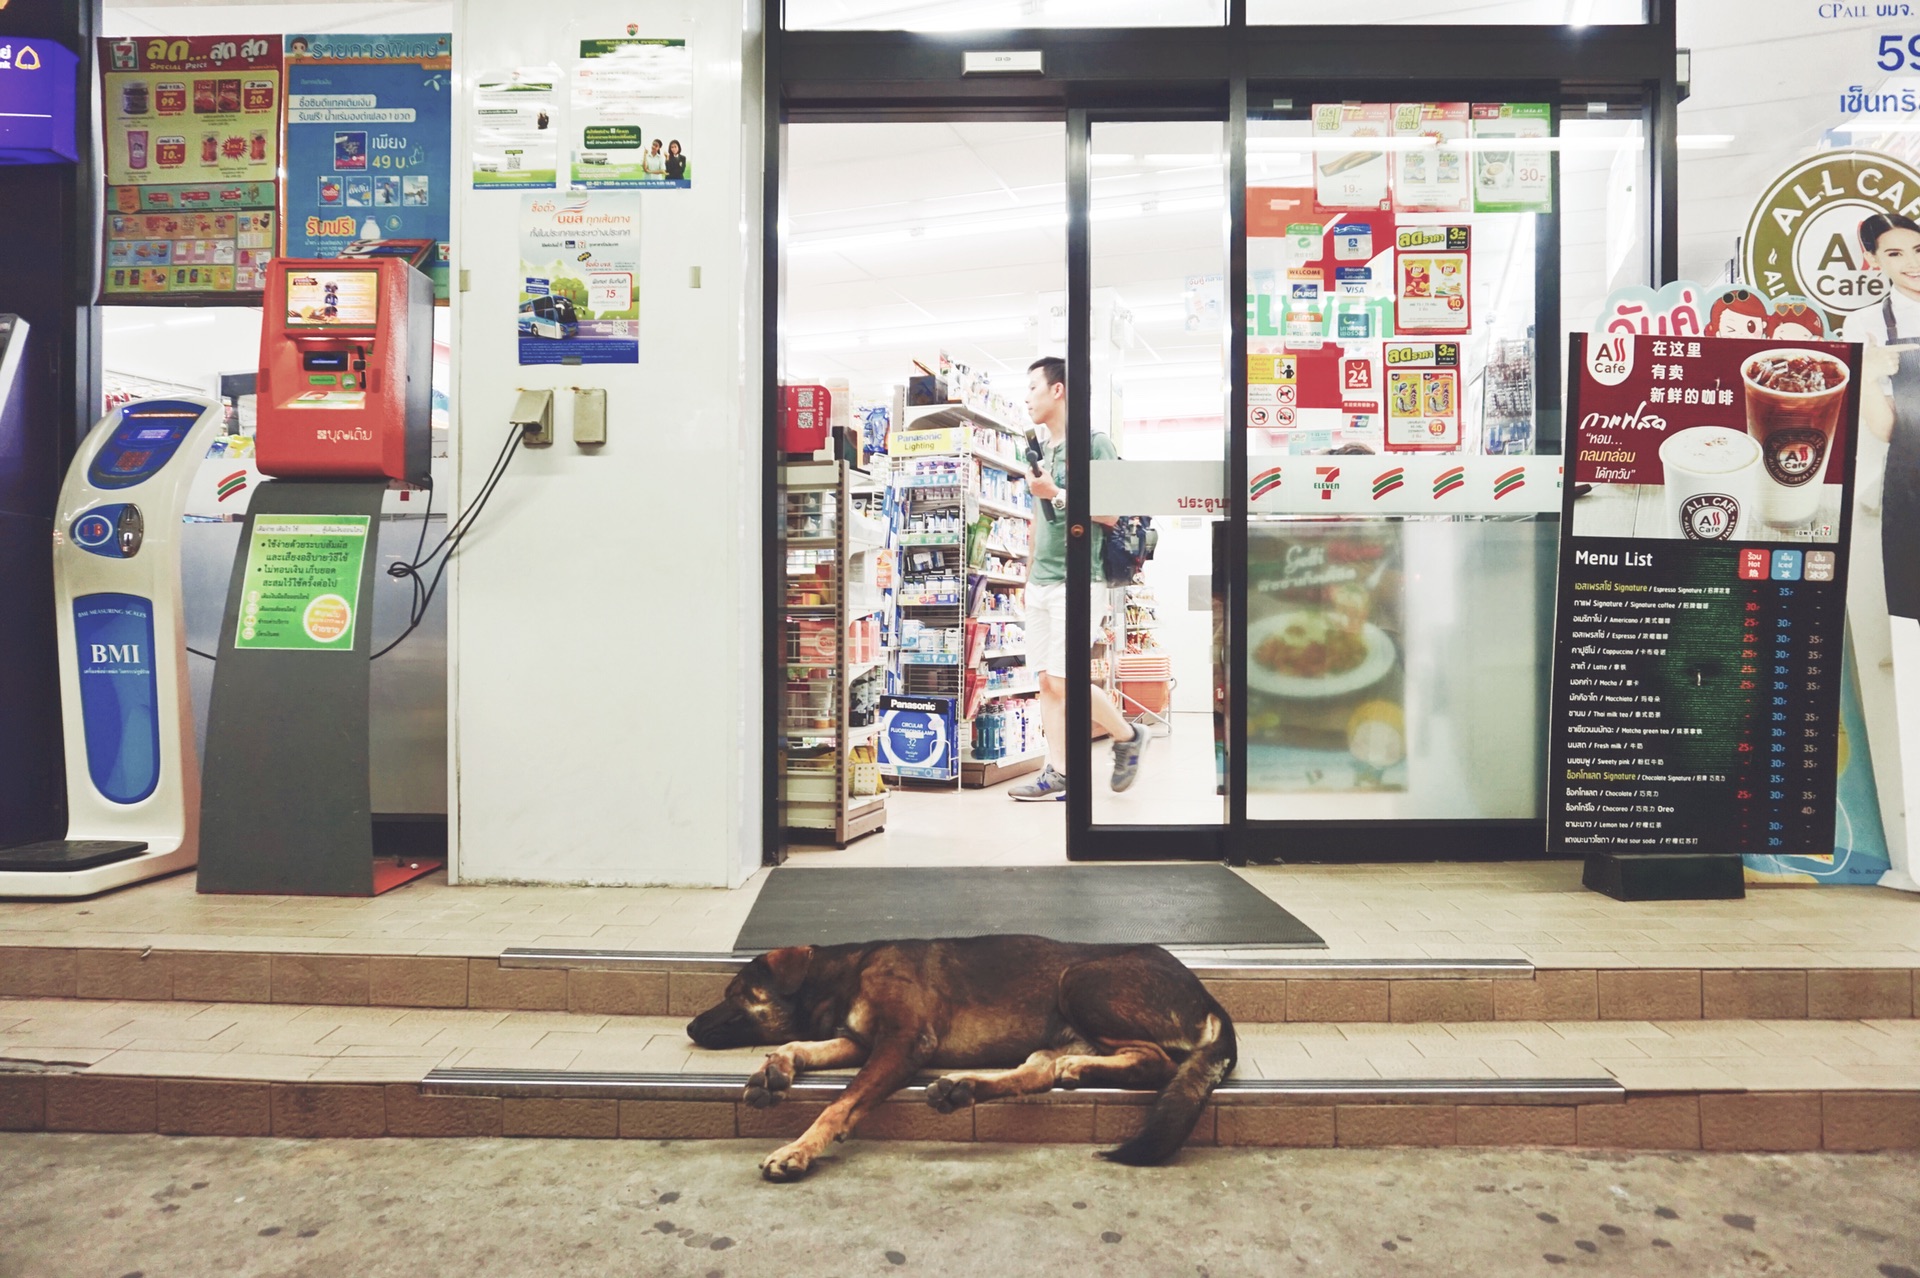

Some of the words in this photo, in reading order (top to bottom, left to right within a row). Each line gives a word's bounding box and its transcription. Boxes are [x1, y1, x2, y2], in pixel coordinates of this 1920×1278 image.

[1876, 4, 1915, 17] บมจ.
[150, 62, 181, 70] SPECIAL
[185, 62, 208, 70] PRICE
[372, 134, 407, 150] เพียง
[372, 155, 392, 169] 49
[1772, 170, 1845, 236] ALL
[306, 215, 355, 236] รับฟรี!
[586, 214, 631, 226] ทุกเส้นทาง
[1399, 230, 1445, 248] ลดราคา
[1449, 228, 1459, 240] 3
[1816, 271, 1884, 296] Café
[606, 290, 616, 299] 15
[1388, 347, 1434, 364] ลดราคา
[1438, 344, 1448, 356] 3
[1652, 340, 1702, 358] 在这里
[1594, 362, 1626, 374] Café
[1651, 364, 1684, 381] 有卖
[1348, 370, 1368, 383] 24
[1650, 386, 1734, 406] 新鲜的咖啡
[1580, 400, 1667, 431] กาแฟสด
[898, 434, 943, 443] Panasonic
[904, 443, 935, 451] Lighting
[1580, 447, 1636, 463] กลมกล่อม
[1316, 466, 1340, 500] 7
[1789, 472, 1809, 482] GREAT
[1686, 498, 1710, 515] ALL
[1712, 497, 1737, 515] CAFE
[1576, 550, 1619, 566] Menu
[1625, 552, 1653, 567] List
[1614, 583, 1648, 594] Signature
[1654, 586, 1677, 594] Espresso
[1678, 586, 1703, 595] Signature
[1593, 600, 1623, 609] Signature
[1630, 602, 1656, 610] Signature
[90, 644, 141, 664] BMI
[1602, 648, 1634, 656] Cappuccino
[890, 699, 936, 711] Panasonic
[1618, 758, 1630, 767] pink
[1603, 771, 1636, 781] Signature
[1657, 805, 1675, 813] Oreo
